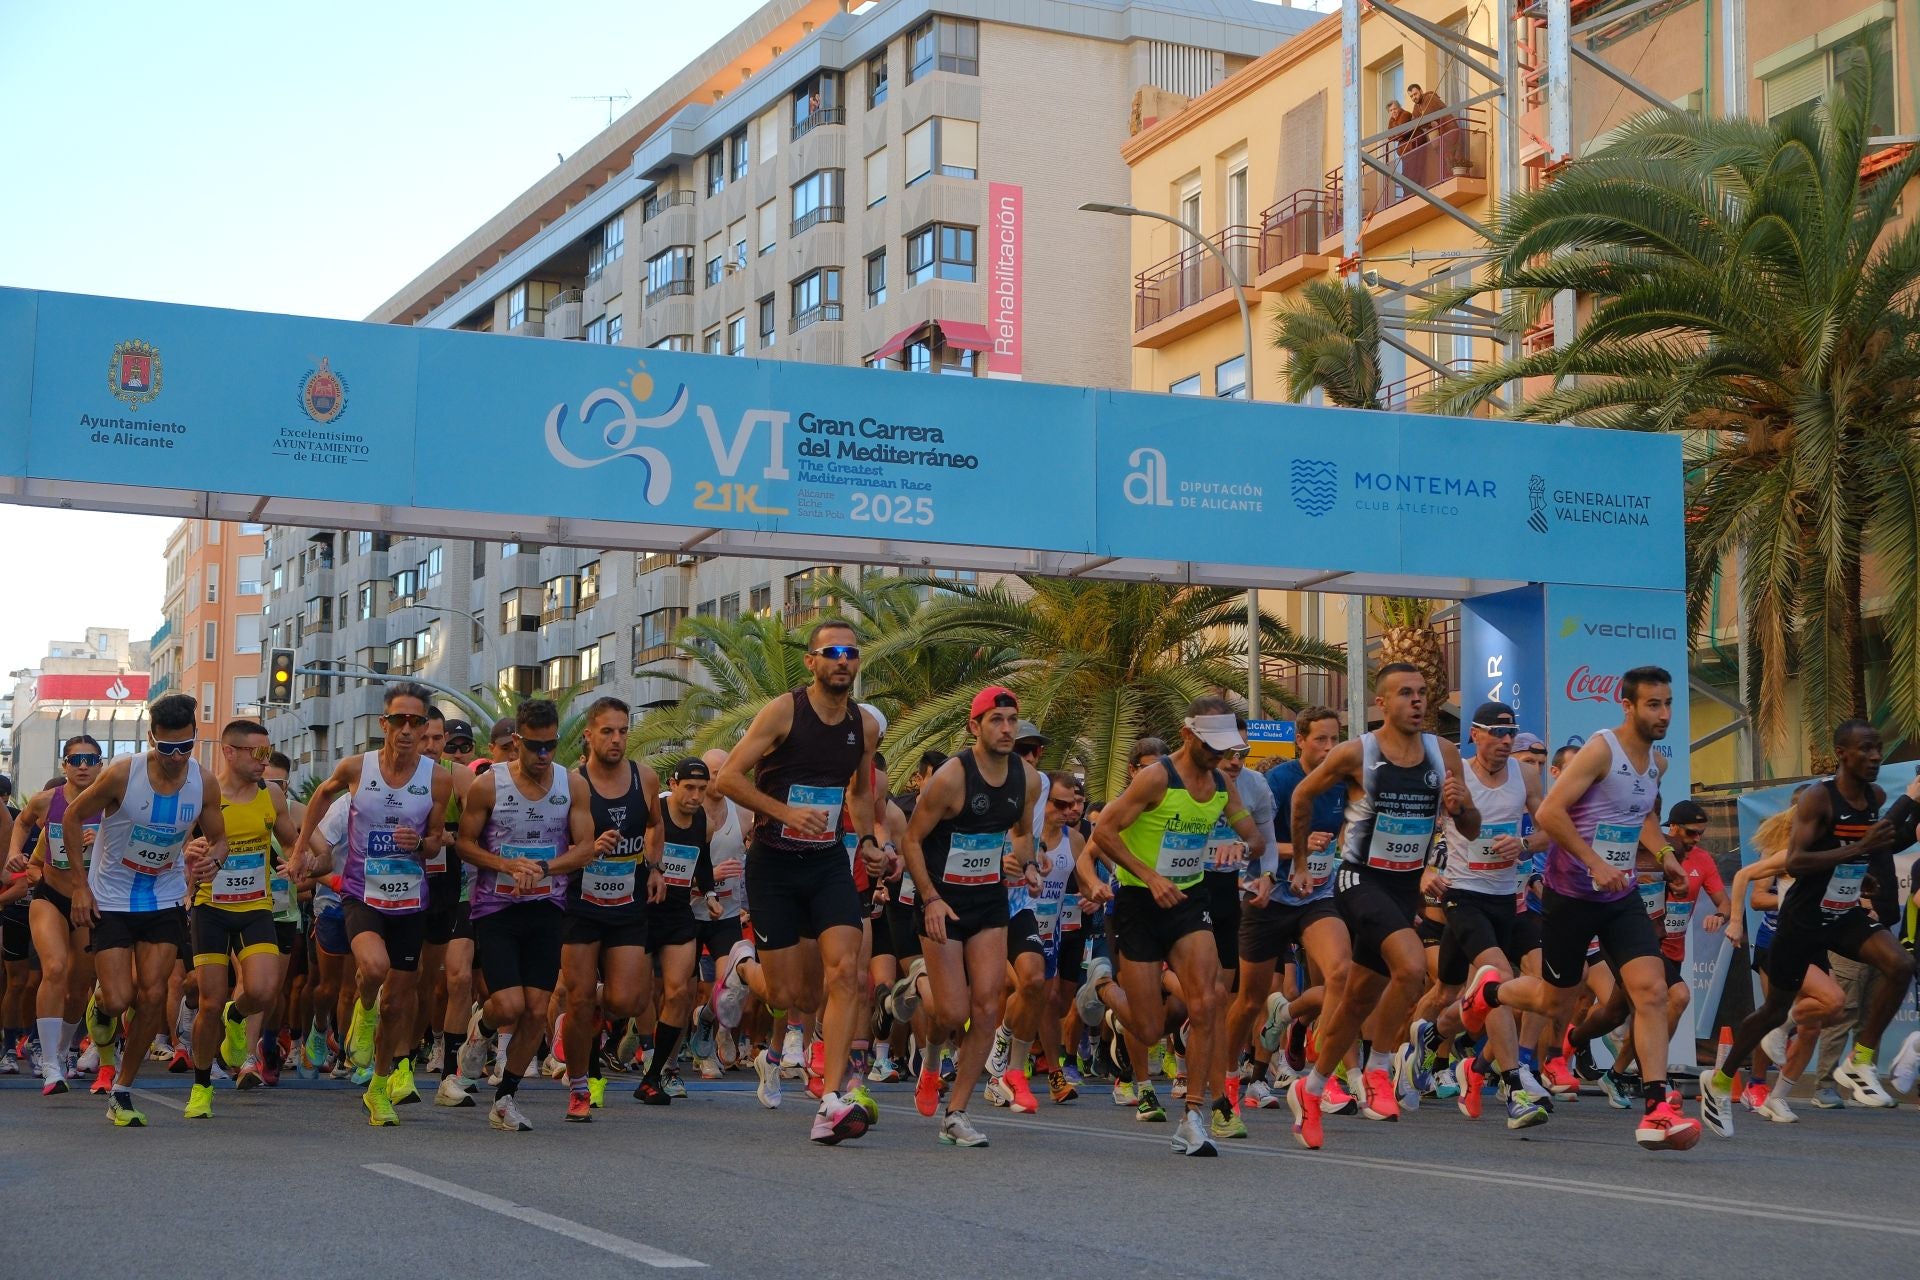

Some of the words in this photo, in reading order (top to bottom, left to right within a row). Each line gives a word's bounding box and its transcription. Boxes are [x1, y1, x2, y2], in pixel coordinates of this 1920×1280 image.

[994, 197, 1016, 356] Rehabilitación
[80, 414, 187, 434] Ayuntamiento
[799, 412, 855, 436] Gran
[859, 417, 945, 443] Carrera
[91, 431, 110, 443] de
[113, 432, 174, 448] Alicante
[273, 439, 369, 455] AYUNTAMIENTO
[697, 404, 790, 480] VI
[293, 452, 307, 461] de
[311, 453, 347, 464] ELCHE
[797, 437, 831, 458] del
[837, 441, 979, 469] Mediterráneo
[798, 459, 824, 471] The
[828, 461, 884, 476] Greatest
[797, 471, 897, 489] Mediterranean
[900, 479, 932, 491] Race
[1180, 481, 1263, 497] DIPUTACIÓN
[1355, 471, 1497, 499] MONTEMAR
[797, 499, 823, 509] Elche
[797, 489, 836, 500] Alicante
[850, 492, 935, 526] 2025
[1181, 497, 1197, 507] DE
[1201, 498, 1263, 512] ALICANTE
[1553, 490, 1652, 509] GENERALITAT
[797, 509, 823, 518] Santa
[826, 511, 845, 519] Pola
[1355, 500, 1390, 511] CLUB
[1396, 502, 1459, 516] ATLÉTICO
[1555, 507, 1650, 527] VALENCIANA
[1584, 622, 1677, 640] vectalia
[1487, 655, 1503, 703] AR
[1247, 722, 1281, 731] LICANTE
[1386, 842, 1419, 853] 3908
[962, 857, 991, 868] 2019
[1606, 850, 1631, 862] 3282
[664, 862, 687, 873] 3086
[226, 876, 255, 887] 3362
[380, 882, 409, 893] 4923
[594, 882, 625, 891] 3080
[1043, 880, 1064, 889] TISMO
[1040, 890, 1061, 900] LANA
[1062, 911, 1073, 919] 79
[1039, 921, 1049, 929] 78
